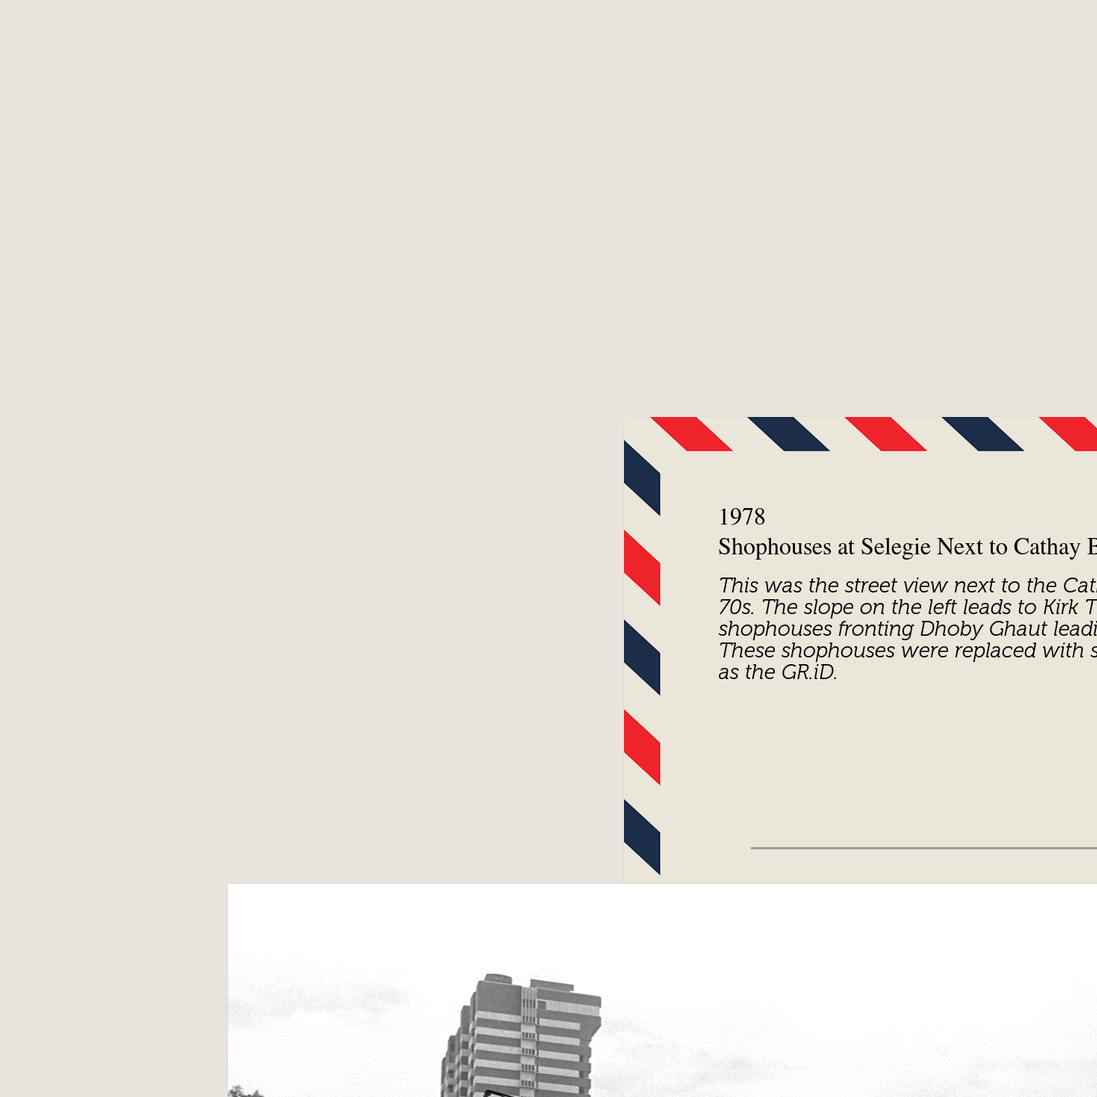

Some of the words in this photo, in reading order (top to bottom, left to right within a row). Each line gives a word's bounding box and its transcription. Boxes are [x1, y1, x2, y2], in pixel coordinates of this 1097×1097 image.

[721, 508, 765, 525] 1978
[719, 538, 831, 560] Shophouses
[838, 540, 855, 555] at
[861, 538, 931, 560] Selegie
[937, 538, 983, 555] Next
[989, 540, 1007, 555] to
[1014, 538, 1080, 560] Cathay
[720, 577, 758, 593] This
[765, 581, 802, 593] was
[809, 577, 839, 593] the
[845, 578, 898, 593] street
[904, 577, 948, 593] view
[954, 578, 995, 593] next
[1002, 578, 1020, 593] to
[1027, 577, 1057, 593] the
[720, 599, 753, 614] 70s.
[763, 599, 797, 614] The
[804, 599, 853, 619] slope
[860, 603, 884, 614] on
[892, 599, 921, 614] the
[928, 599, 957, 614] left
[964, 599, 1011, 614] leads
[1018, 600, 1036, 614] to
[1044, 599, 1079, 614] Kirk
[719, 621, 832, 641] shophouses
[839, 621, 915, 641] fronting
[921, 621, 984, 641] Dhoby
[990, 621, 1048, 636] Ghaut
[720, 642, 775, 658] These
[781, 642, 895, 662] shophouses
[902, 646, 948, 658] were
[955, 642, 1036, 662] replaced
[1043, 642, 1083, 658] with
[719, 668, 739, 679] as
[746, 664, 775, 679] the
[782, 664, 836, 679] GR.iD.
